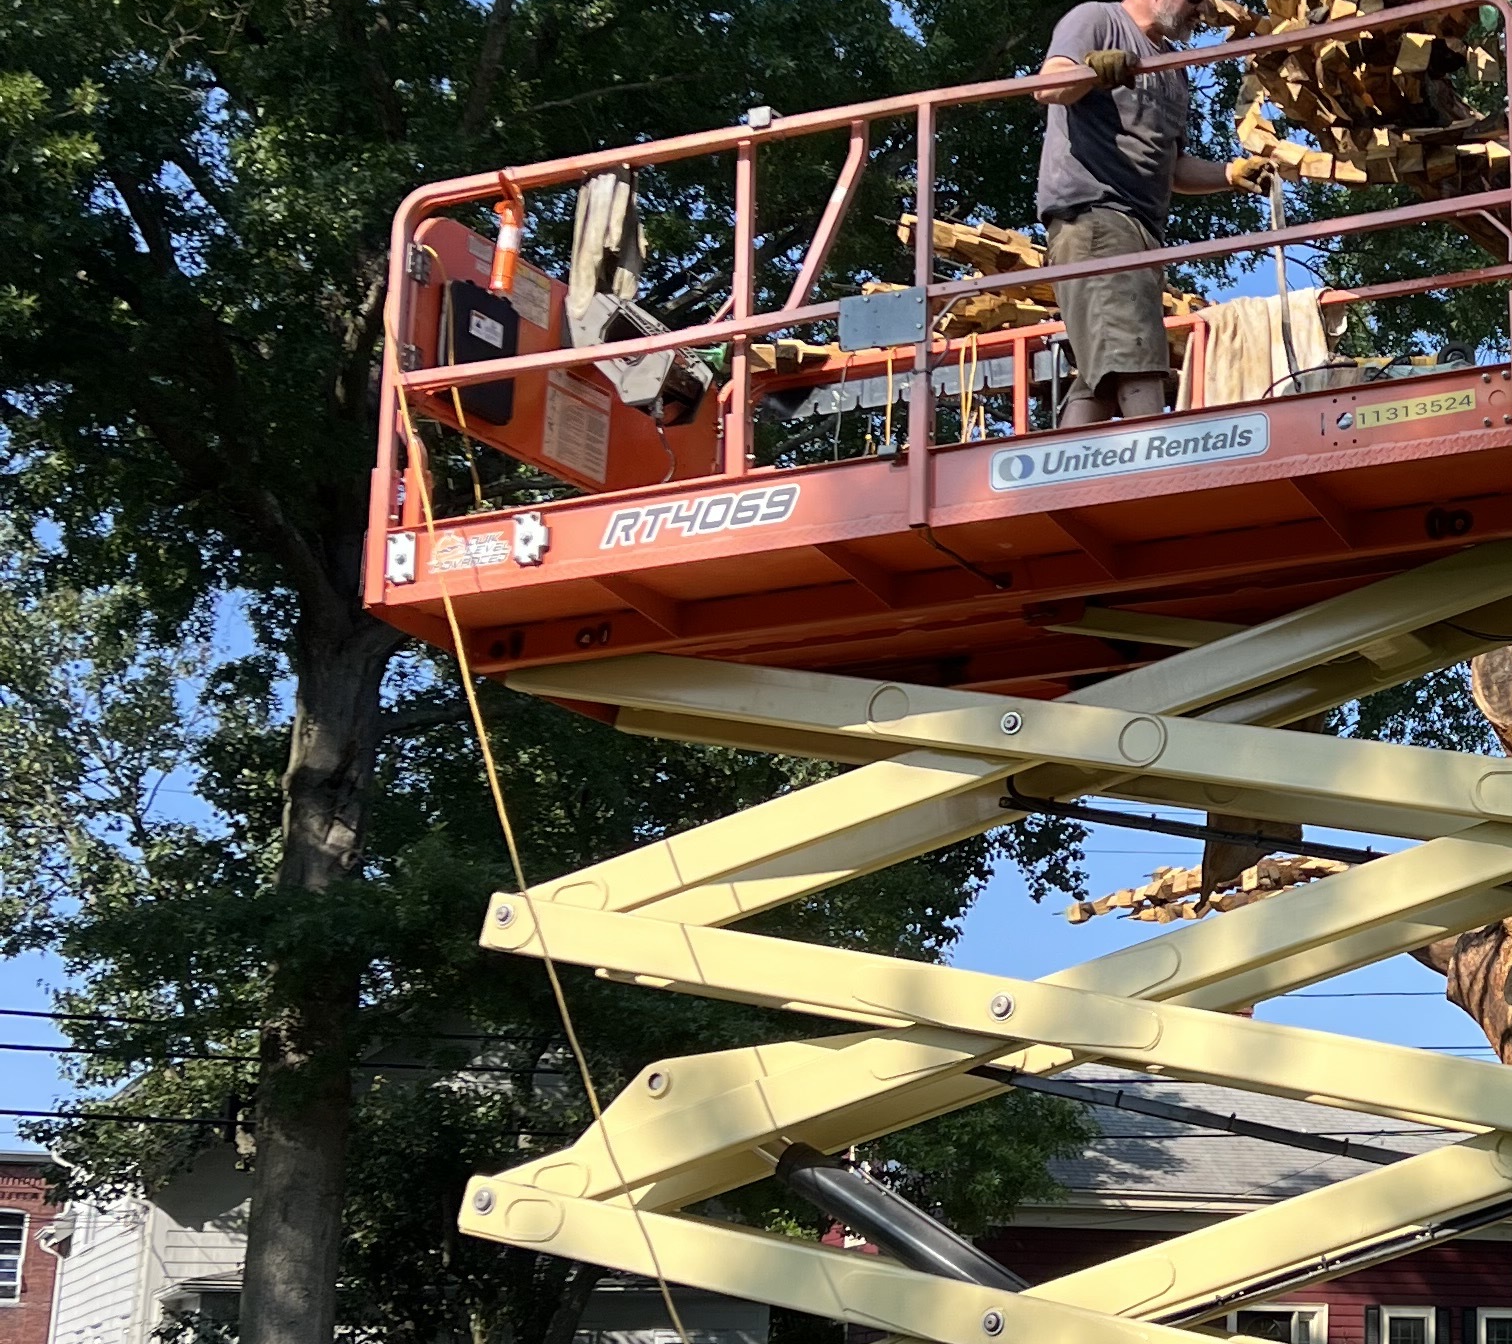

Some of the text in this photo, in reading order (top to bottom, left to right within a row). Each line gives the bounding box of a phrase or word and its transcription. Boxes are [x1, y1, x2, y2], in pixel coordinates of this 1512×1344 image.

[1358, 394, 1474, 425] 11313524
[1042, 425, 1254, 475] United Rentals
[602, 485, 799, 547] RT4069
[464, 542, 509, 557] LEVEL
